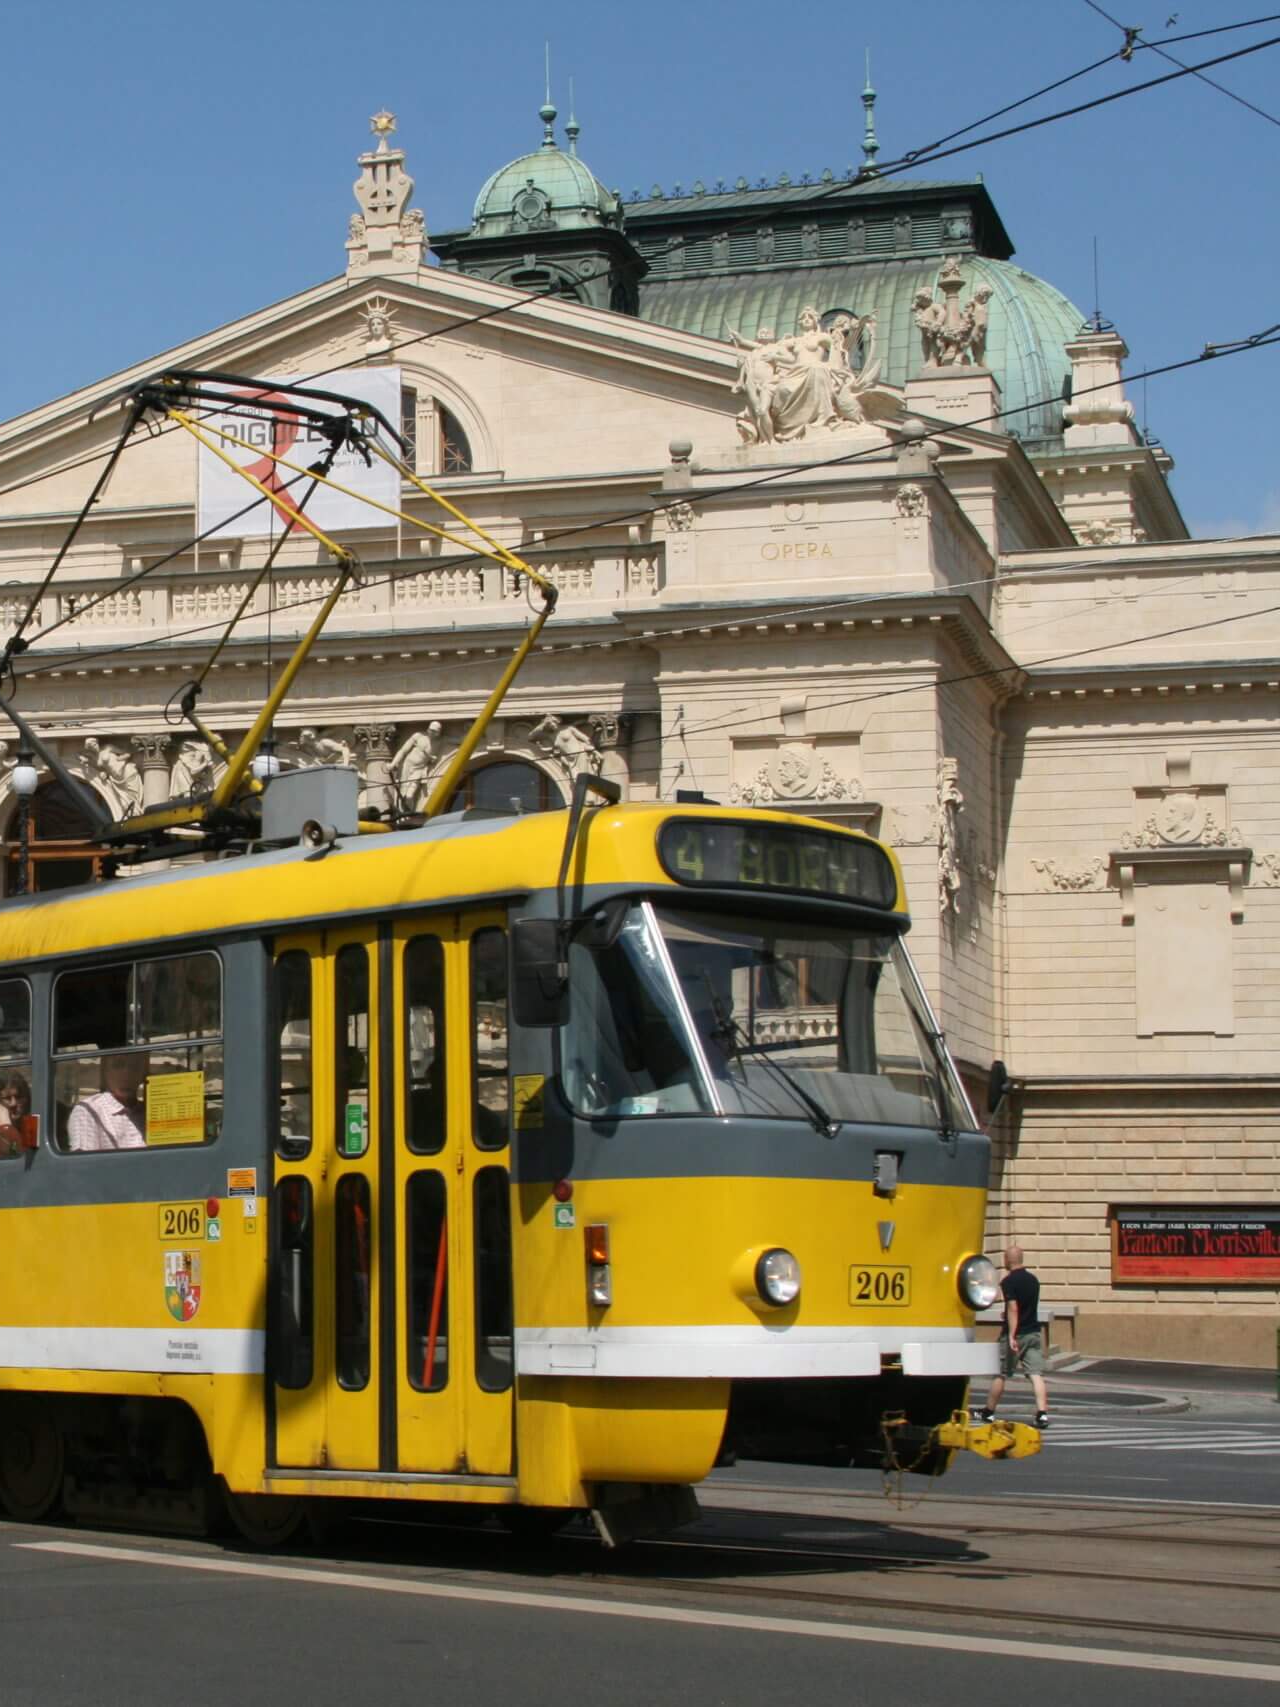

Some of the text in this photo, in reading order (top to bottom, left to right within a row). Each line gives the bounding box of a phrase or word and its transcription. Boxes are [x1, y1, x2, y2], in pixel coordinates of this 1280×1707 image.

[761, 543, 832, 560] OPERA
[676, 831, 859, 895] 4 BORY
[164, 1208, 200, 1234] 206
[1120, 1229, 1185, 1254] Fantom
[856, 1271, 905, 1301] 206
